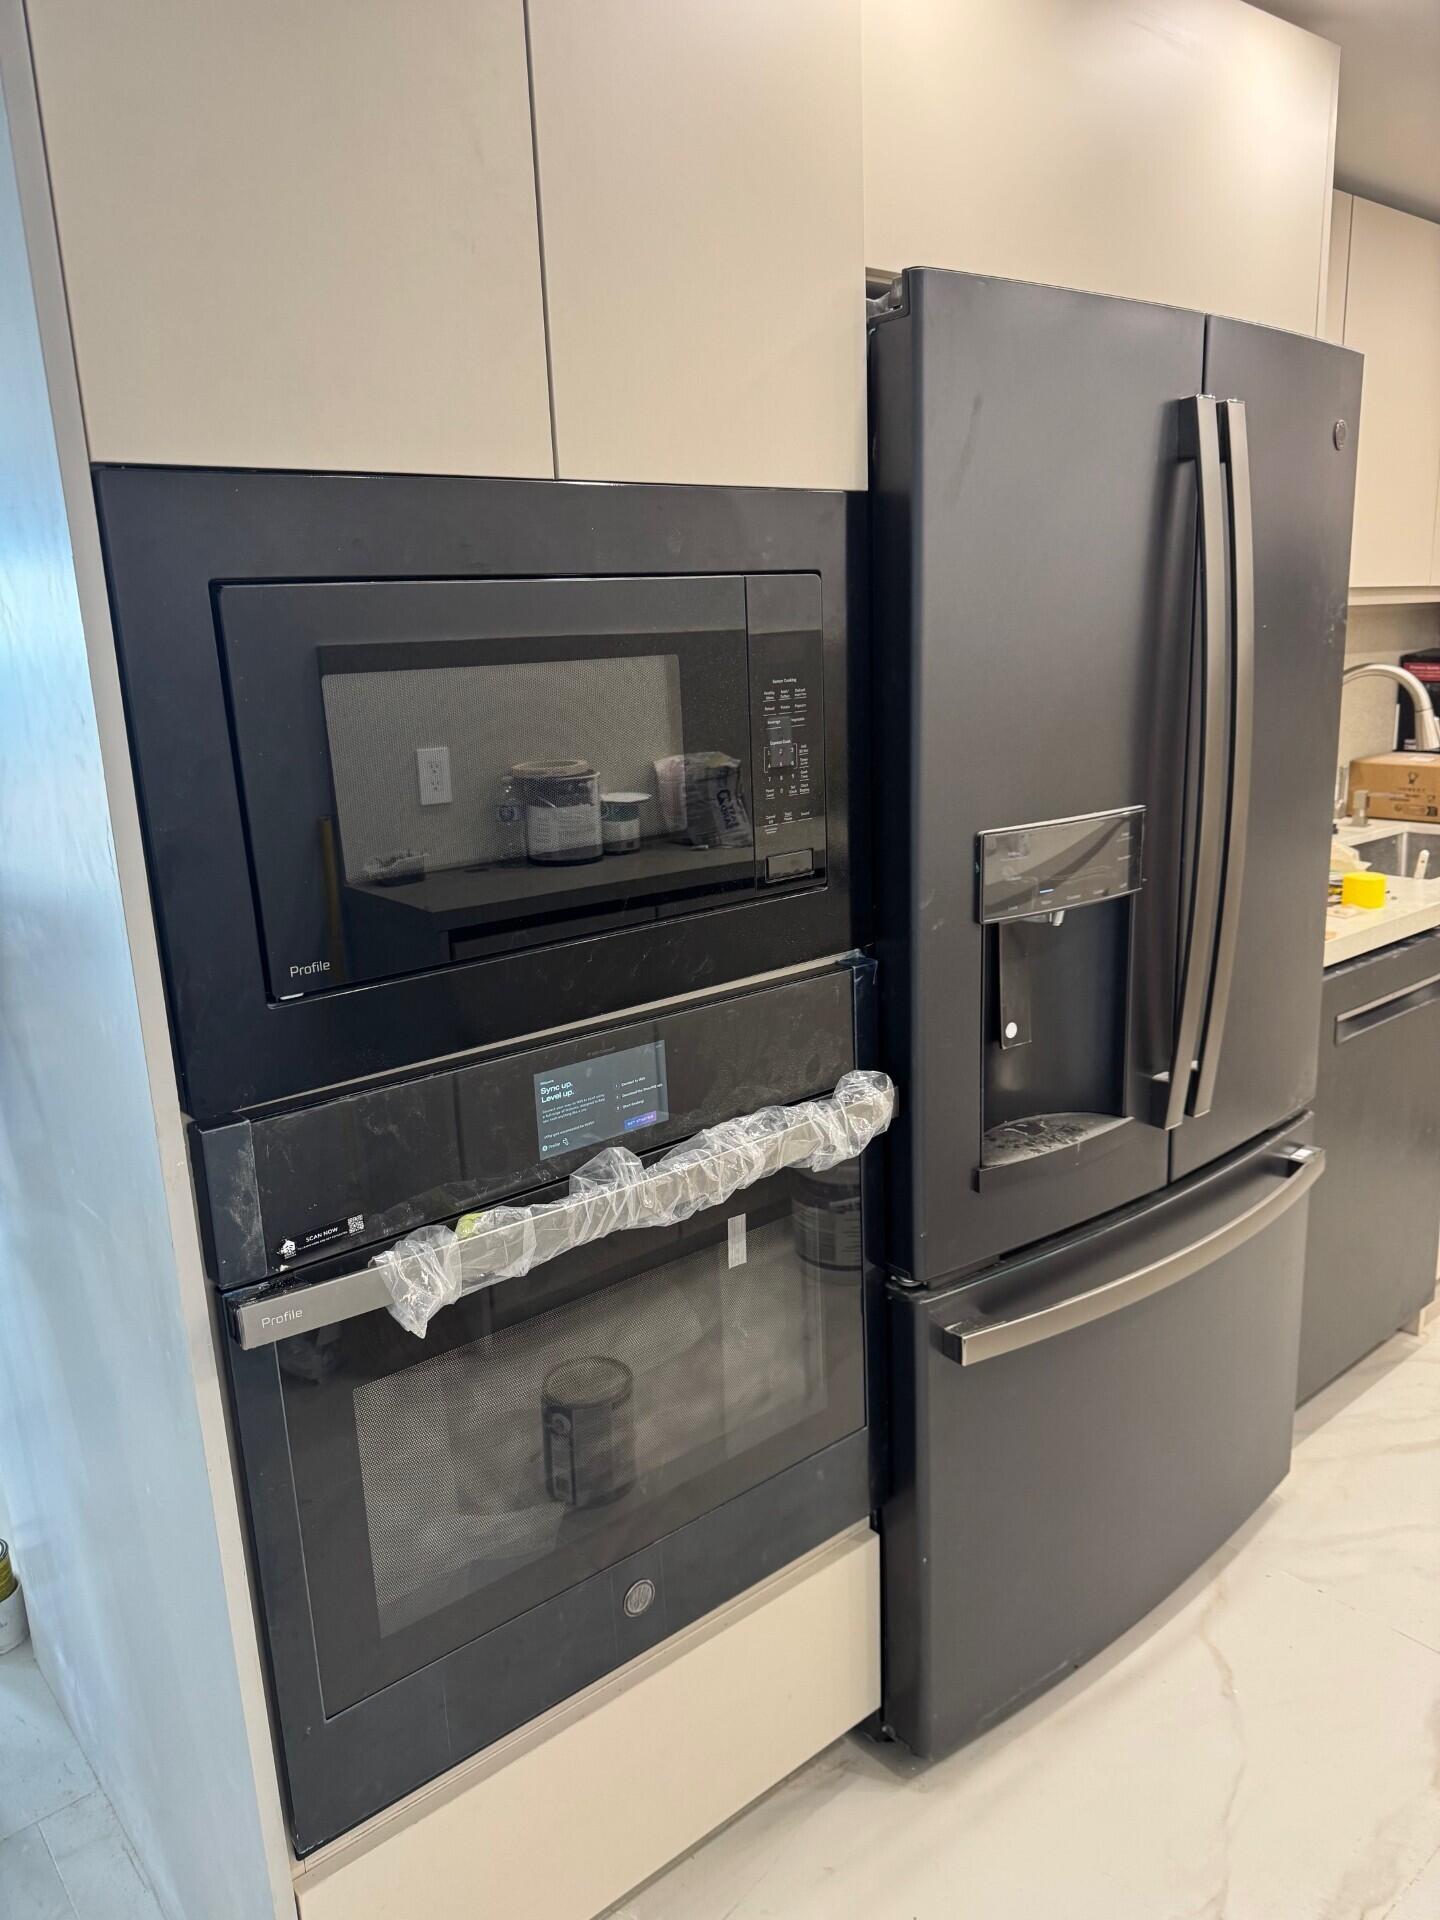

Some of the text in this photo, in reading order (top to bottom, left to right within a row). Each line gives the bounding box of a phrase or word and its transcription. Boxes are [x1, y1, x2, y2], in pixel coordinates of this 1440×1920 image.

[289, 960, 331, 978] Profile
[540, 1084, 560, 1095] Sync
[561, 1081, 573, 1090] up.
[541, 1090, 575, 1104] Level up.
[305, 1232, 323, 1243] SCAN
[323, 1226, 339, 1237] NOW
[261, 1309, 303, 1329] Profile
